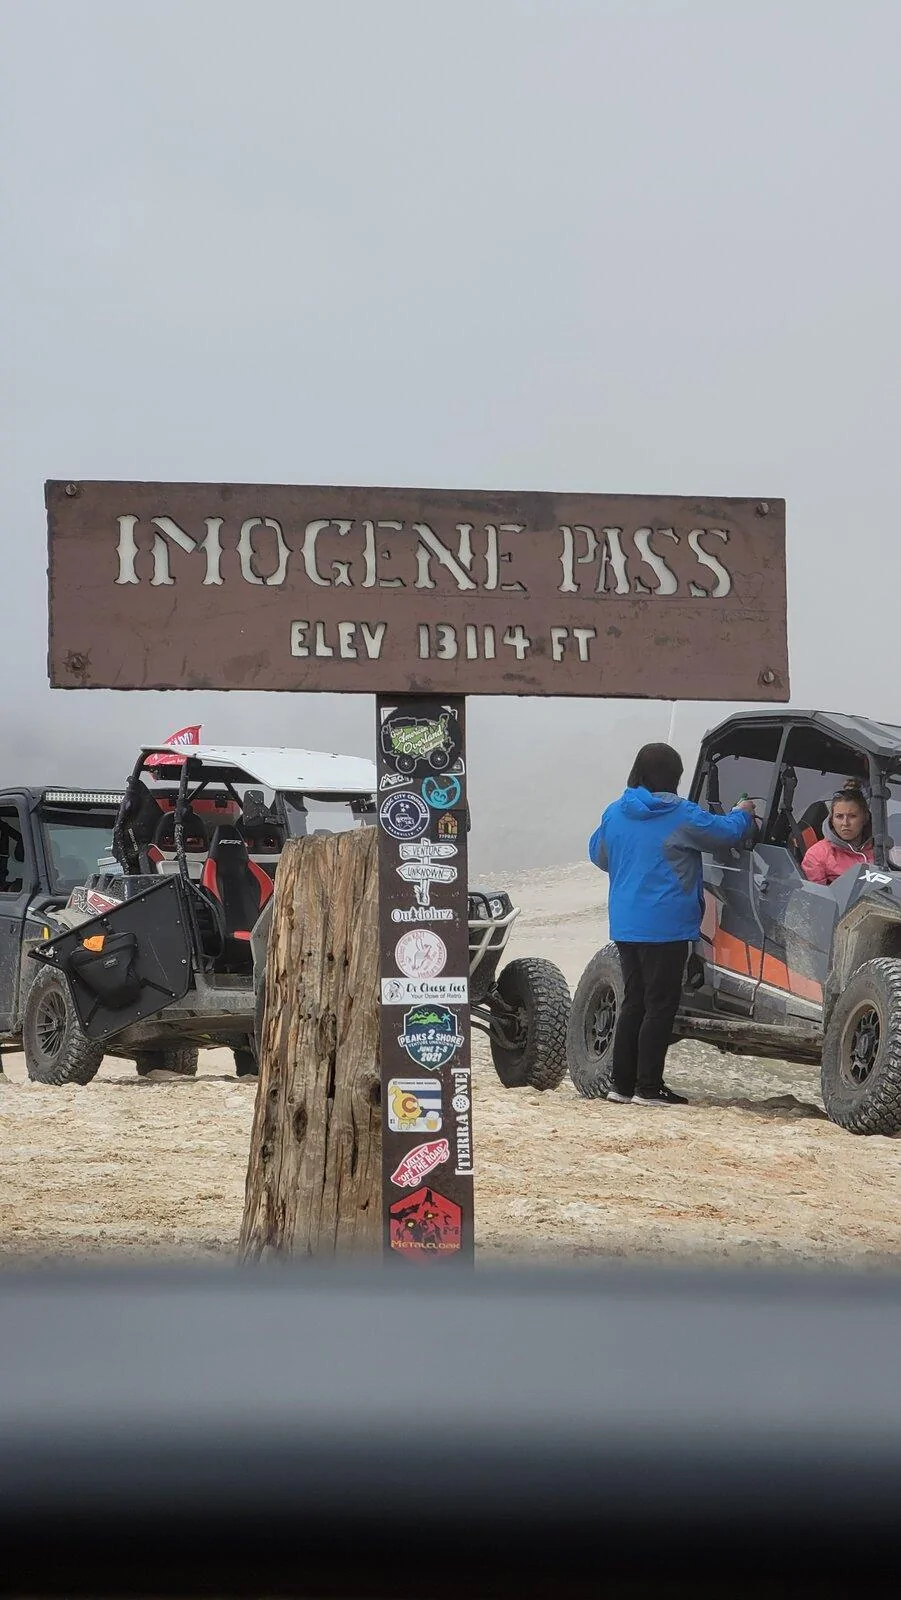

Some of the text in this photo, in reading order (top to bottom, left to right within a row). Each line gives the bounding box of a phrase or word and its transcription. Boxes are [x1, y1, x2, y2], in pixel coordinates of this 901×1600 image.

[114, 514, 731, 598] IMOGENE PASS
[290, 620, 597, 662] ELEV 13114 FT
[382, 797, 394, 813] MUSIC
[412, 846, 441, 856] VENTURE
[407, 866, 445, 878] UNKNOWN
[858, 870, 893, 884] XP
[400, 1029, 462, 1045] PEAKS 2 SHORE
[420, 1053, 442, 1062] 2021
[403, 1145, 429, 1169] VALLEY
[412, 1161, 429, 1174] THE
